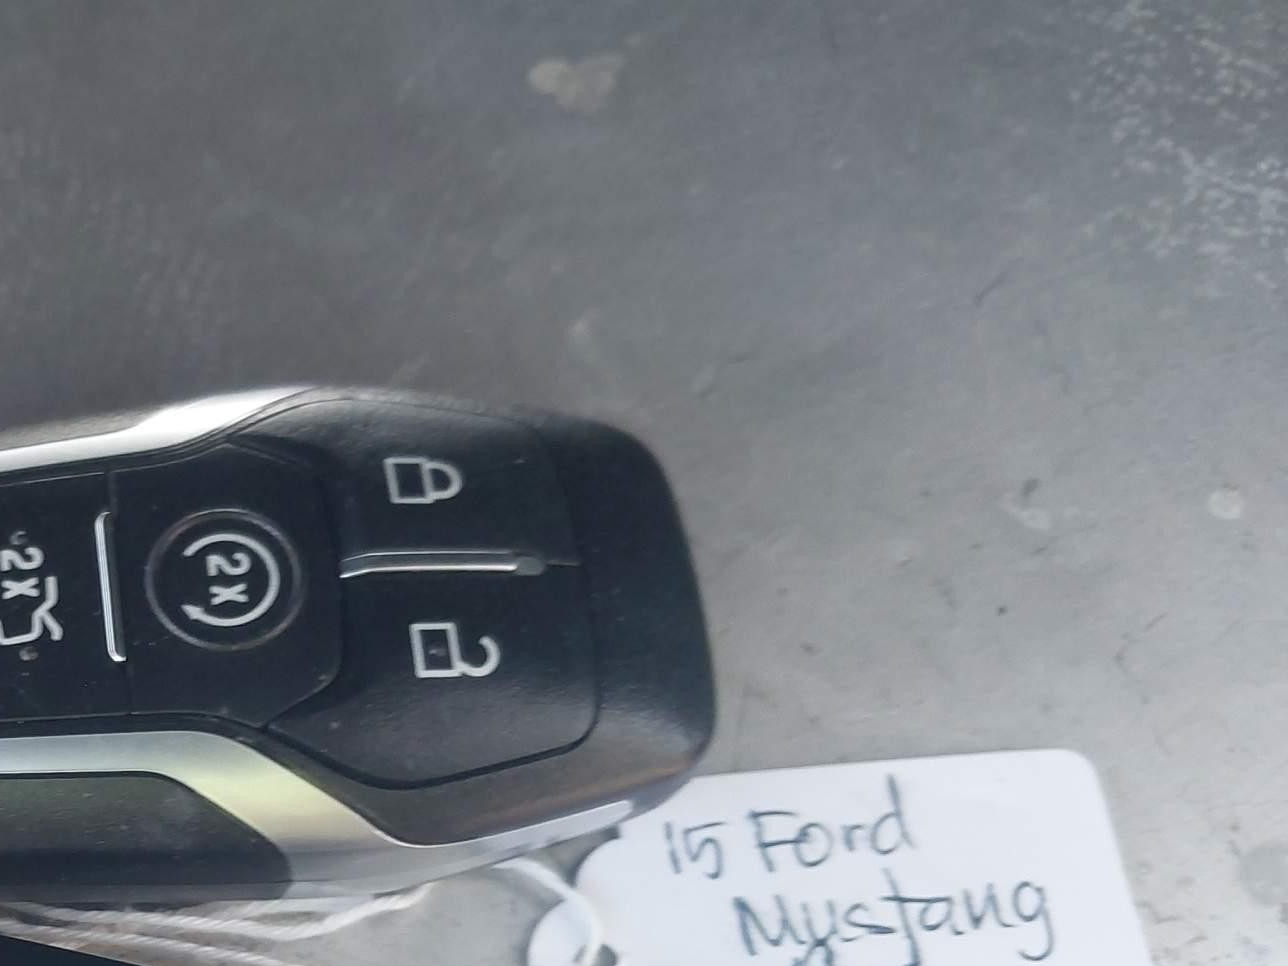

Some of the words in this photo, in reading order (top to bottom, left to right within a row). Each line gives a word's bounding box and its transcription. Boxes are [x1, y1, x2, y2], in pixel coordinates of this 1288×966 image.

[664, 820, 725, 879] 15
[748, 773, 916, 873] Ford
[733, 866, 1055, 961] Mustang
